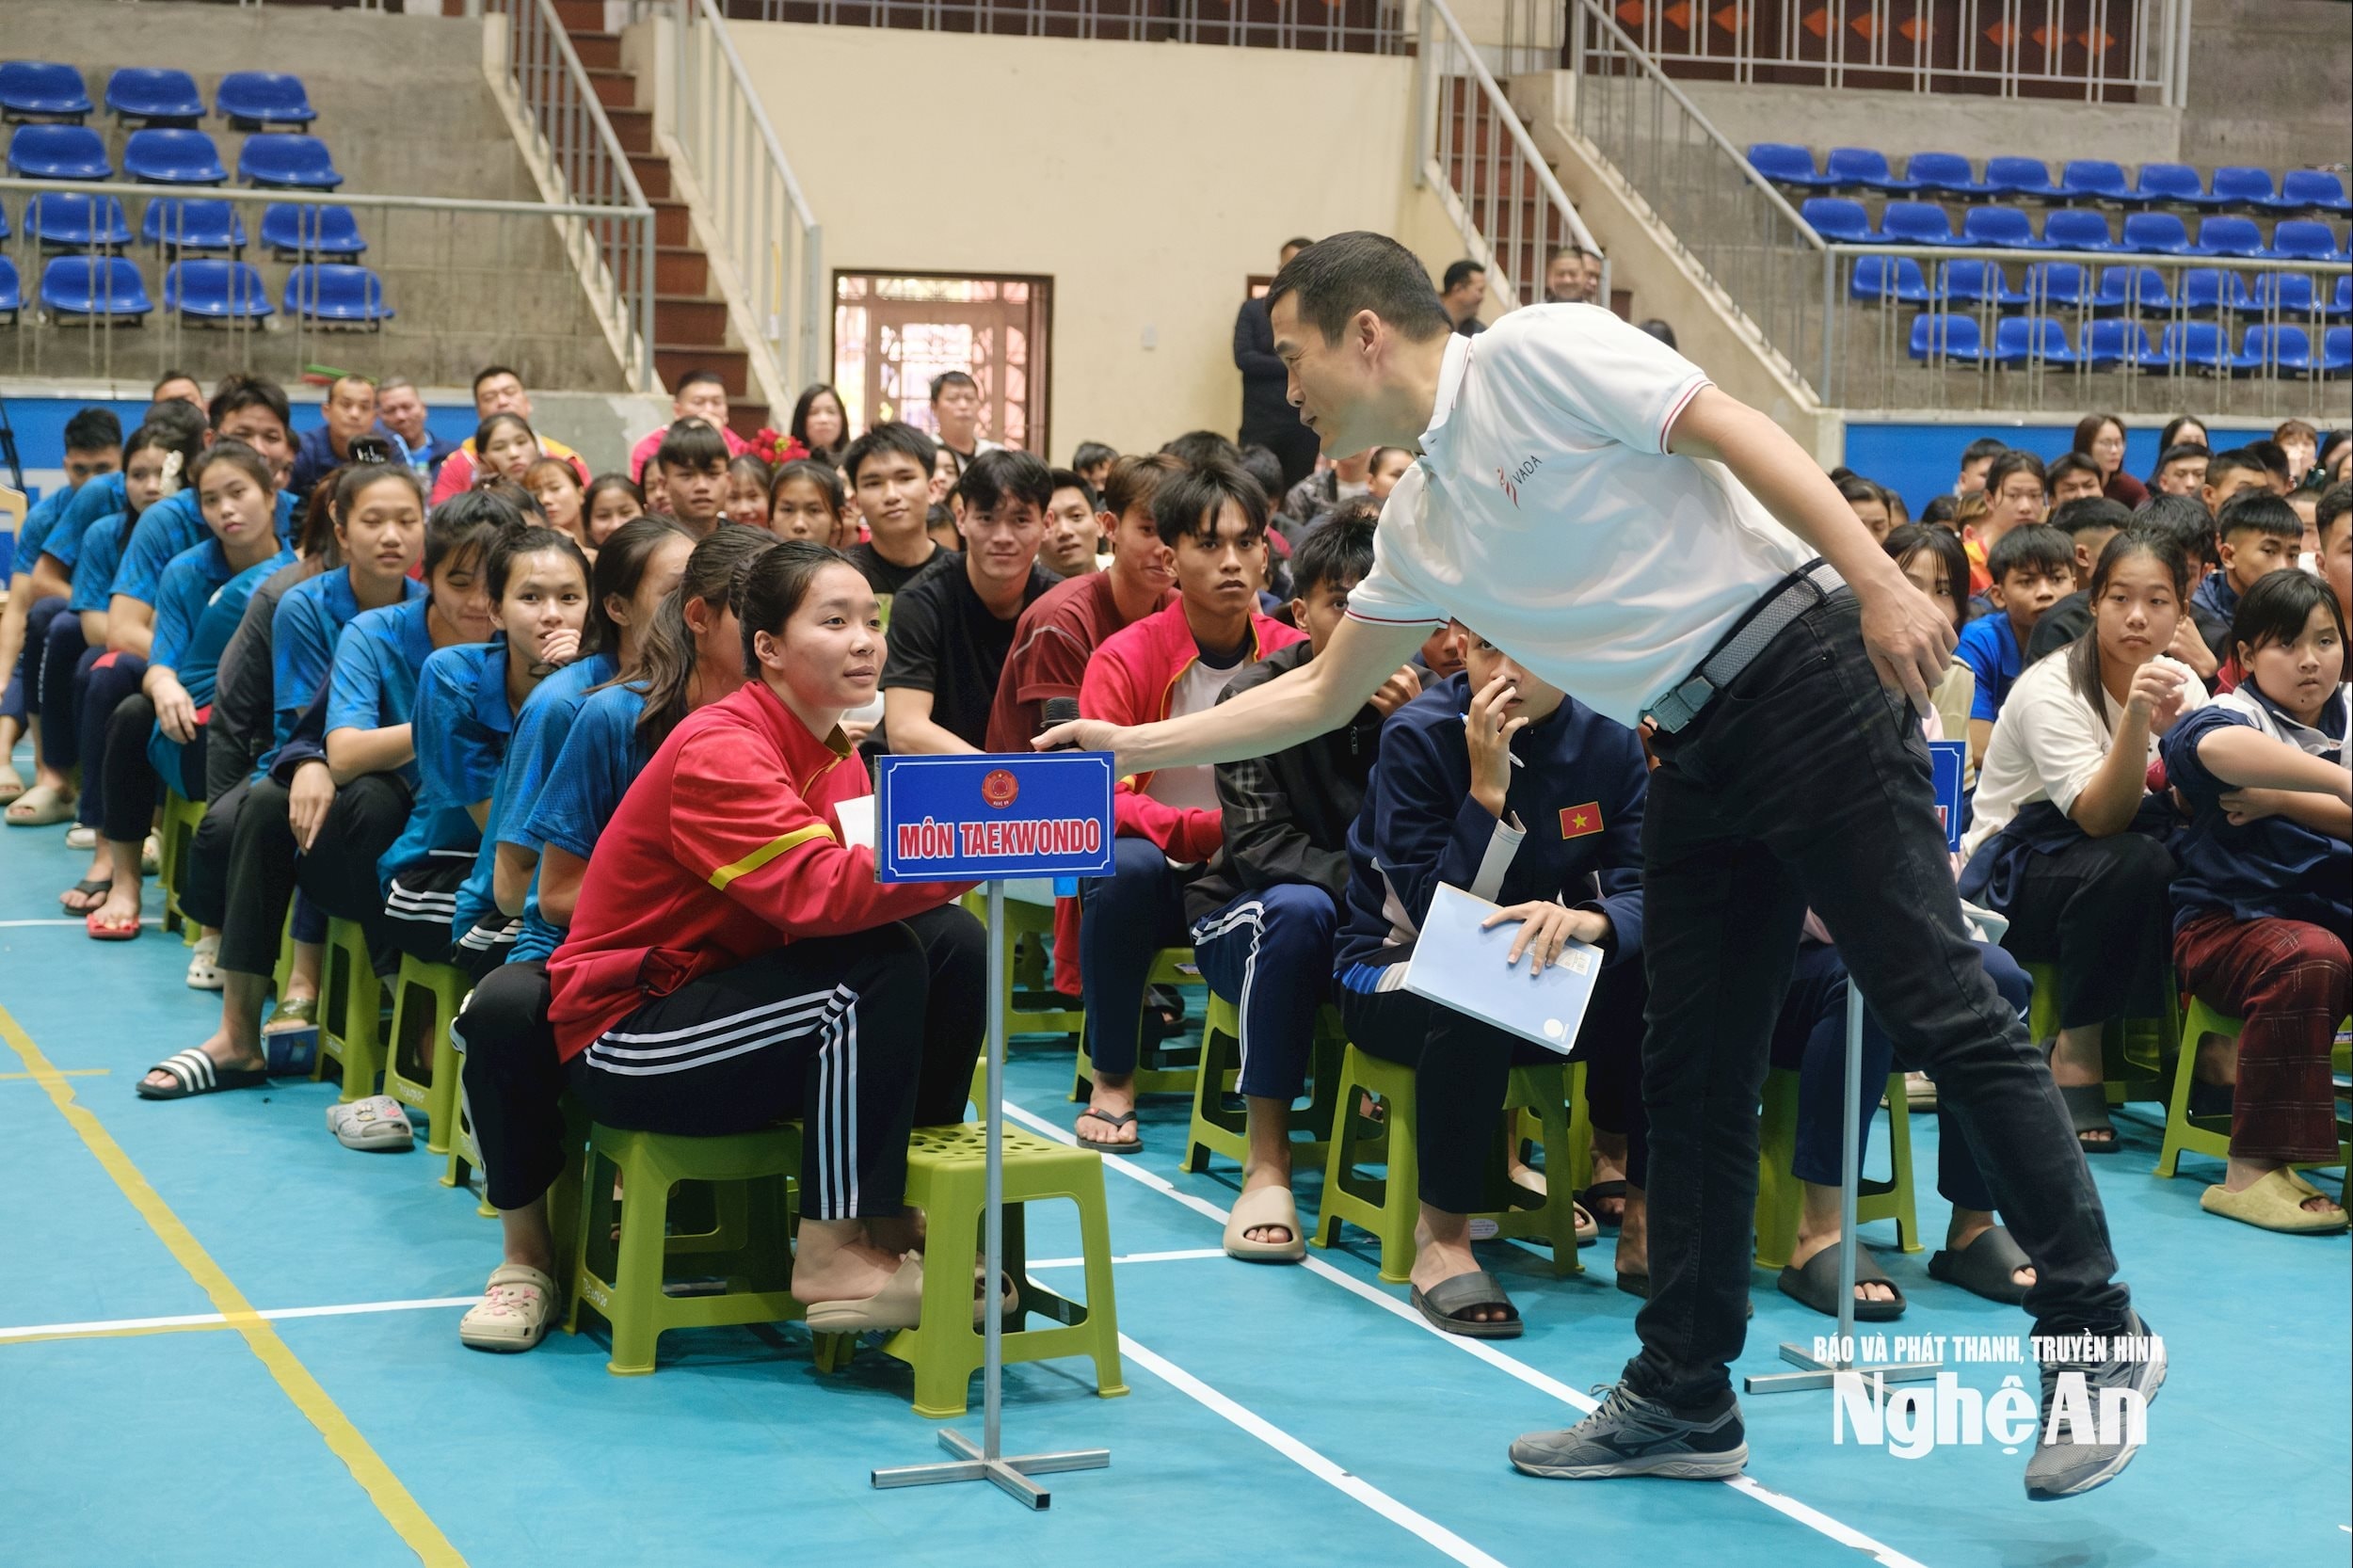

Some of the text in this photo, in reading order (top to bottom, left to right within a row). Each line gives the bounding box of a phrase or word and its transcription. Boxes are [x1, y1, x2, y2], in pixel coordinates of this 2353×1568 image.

[1512, 455, 1543, 485] VADA
[898, 816, 1101, 860] MÔN TAEKWONDO
